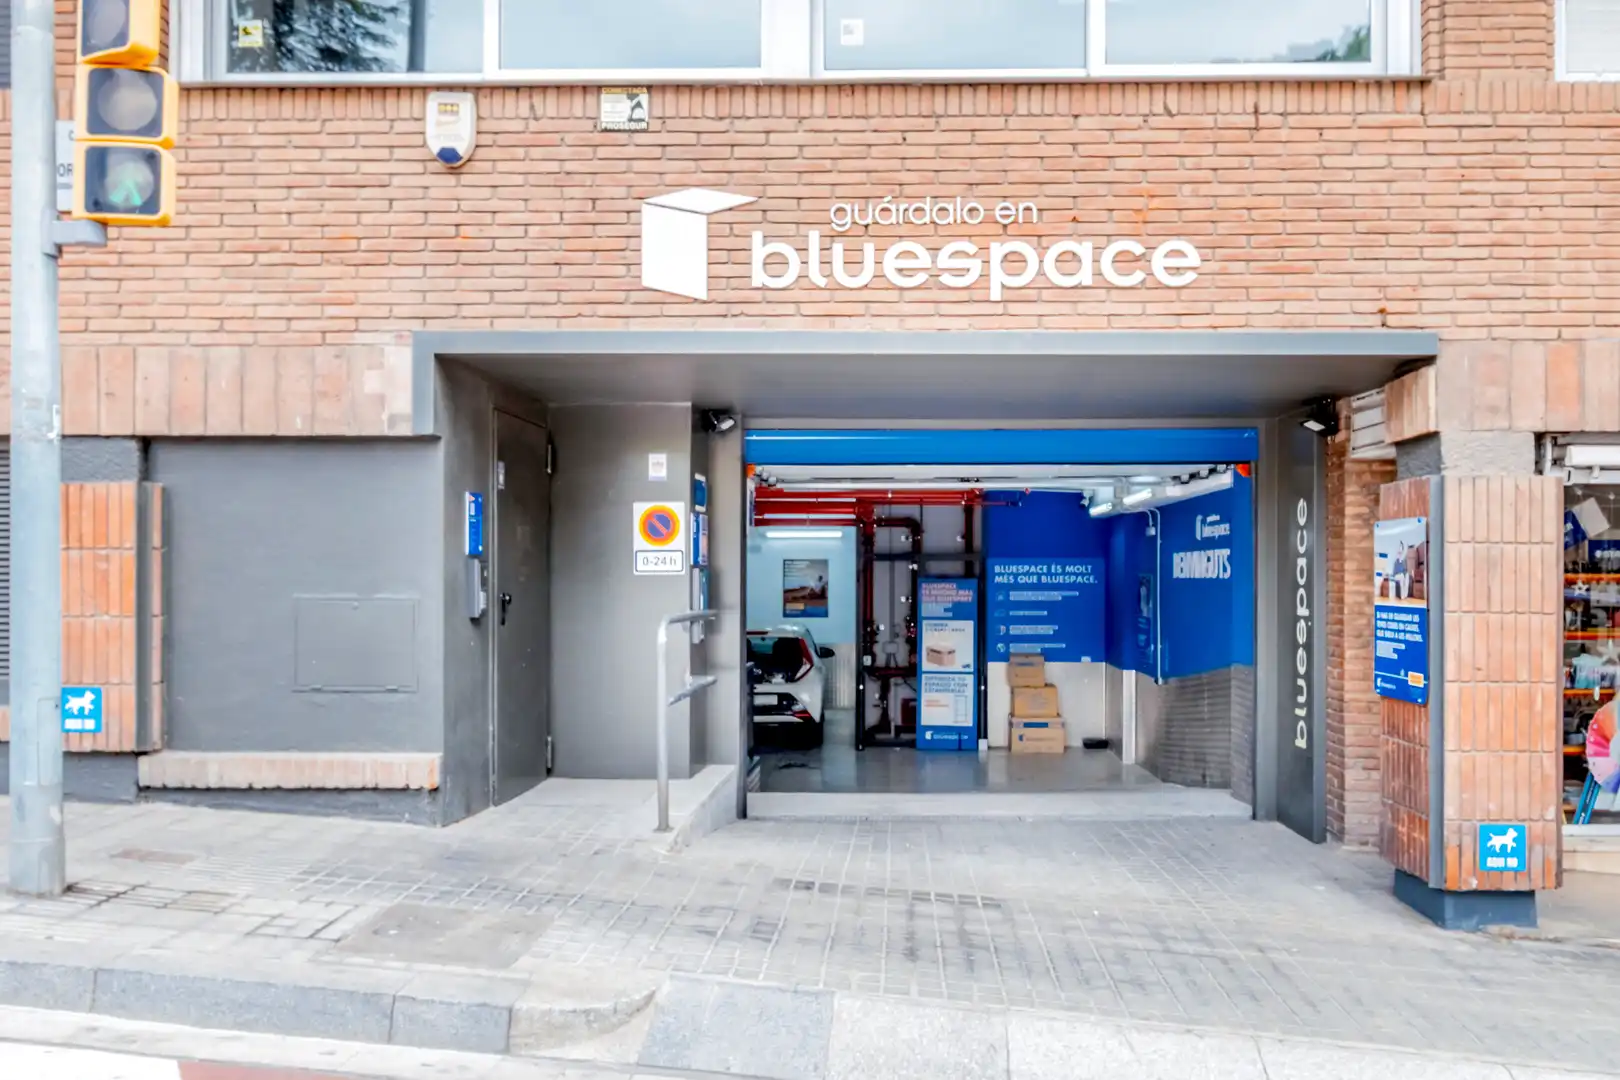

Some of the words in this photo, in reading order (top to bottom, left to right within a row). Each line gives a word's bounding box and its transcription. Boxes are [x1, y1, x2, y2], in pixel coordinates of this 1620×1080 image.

[602, 122, 648, 131] PROSEGUR
[829, 196, 984, 232] guárdalo
[995, 202, 1038, 224] en
[750, 230, 1202, 302] bluespace
[642, 556, 667, 566] 0-24
[994, 565, 1048, 573] BLUESPACE
[1051, 562, 1062, 573] ÉS
[1065, 565, 1092, 573] MOLT
[994, 574, 1014, 583] MÉS
[1017, 575, 1038, 584] QUE
[1041, 575, 1098, 584] BLUESPACE.
[1295, 498, 1310, 749] bluespace
